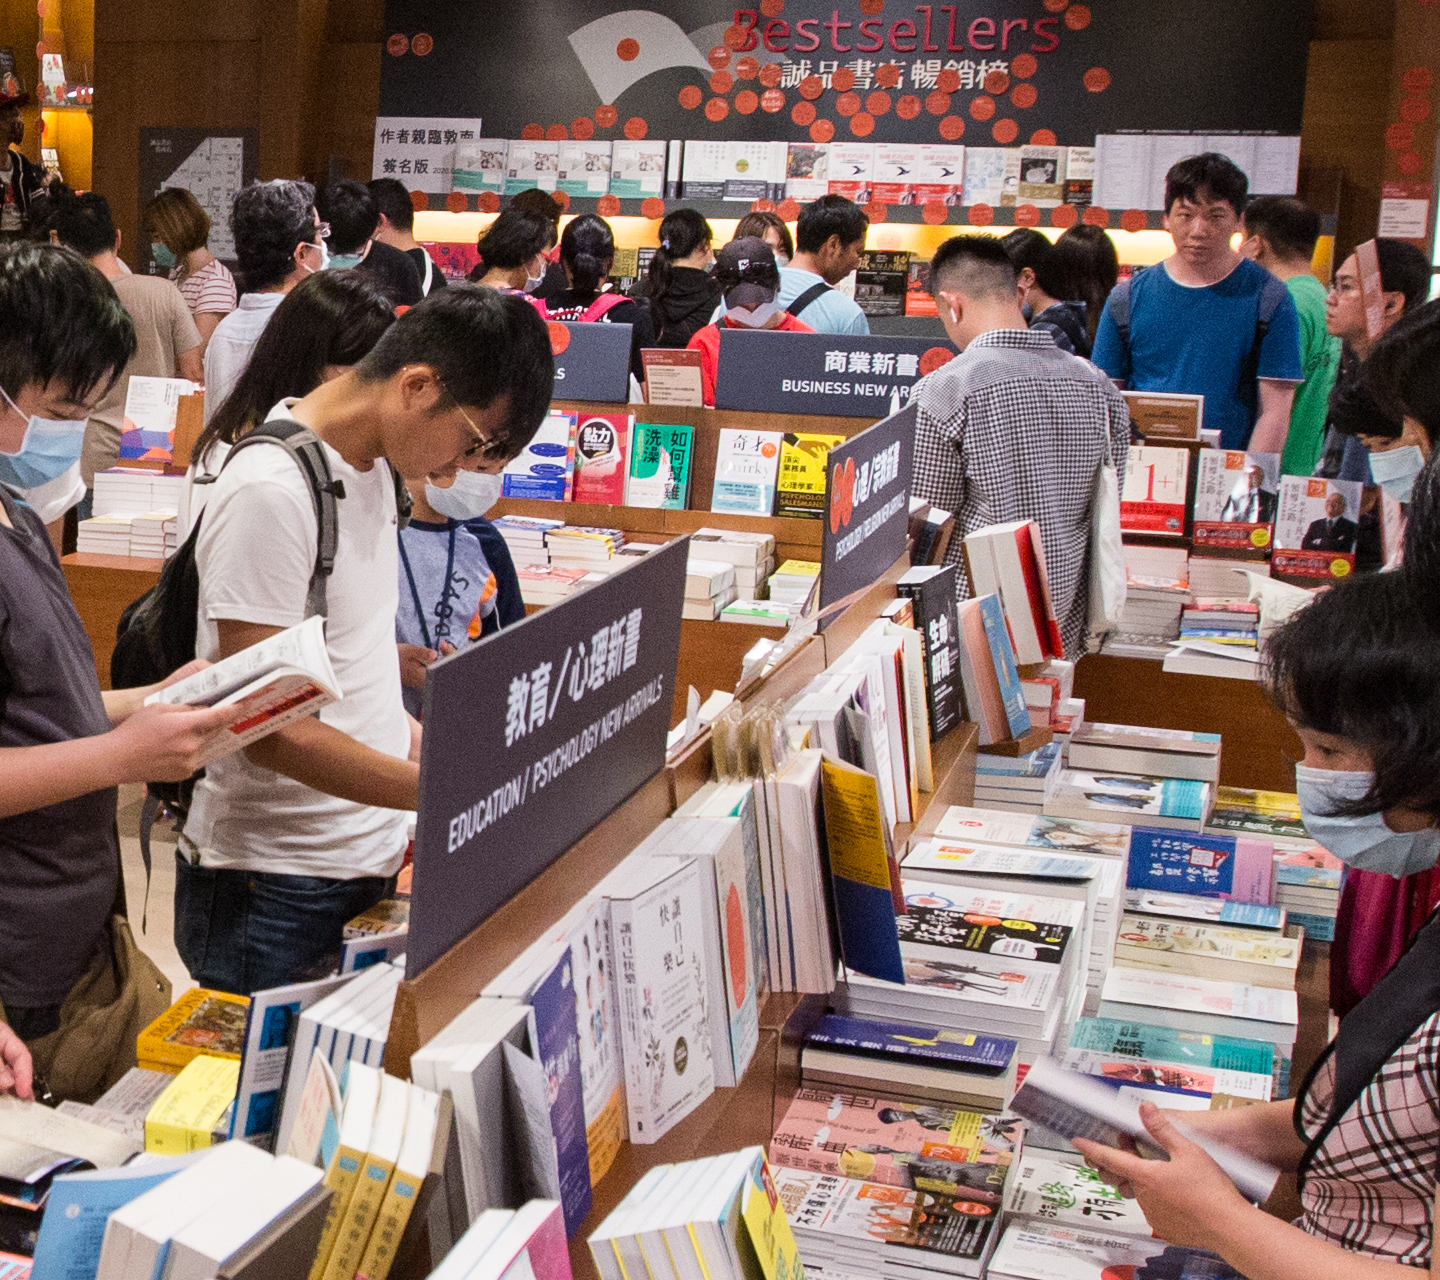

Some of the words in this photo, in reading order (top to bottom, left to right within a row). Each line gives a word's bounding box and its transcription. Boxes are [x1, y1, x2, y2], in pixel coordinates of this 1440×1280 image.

[731, 4, 1061, 53] Bestsellers
[382, 158, 430, 175] 簽名版
[824, 350, 920, 377] 商業新書
[781, 378, 852, 396] BUSINESS
[853, 381, 888, 397] NEW
[642, 428, 662, 465] 洗澡
[731, 433, 764, 452] 奇才
[504, 606, 644, 748] 教育/心理新書
[447, 784, 520, 855] EDUCATION
[532, 723, 601, 795] PSYCHOLOGY
[600, 710, 621, 745] NEW
[621, 673, 665, 728] ARRIVALS
